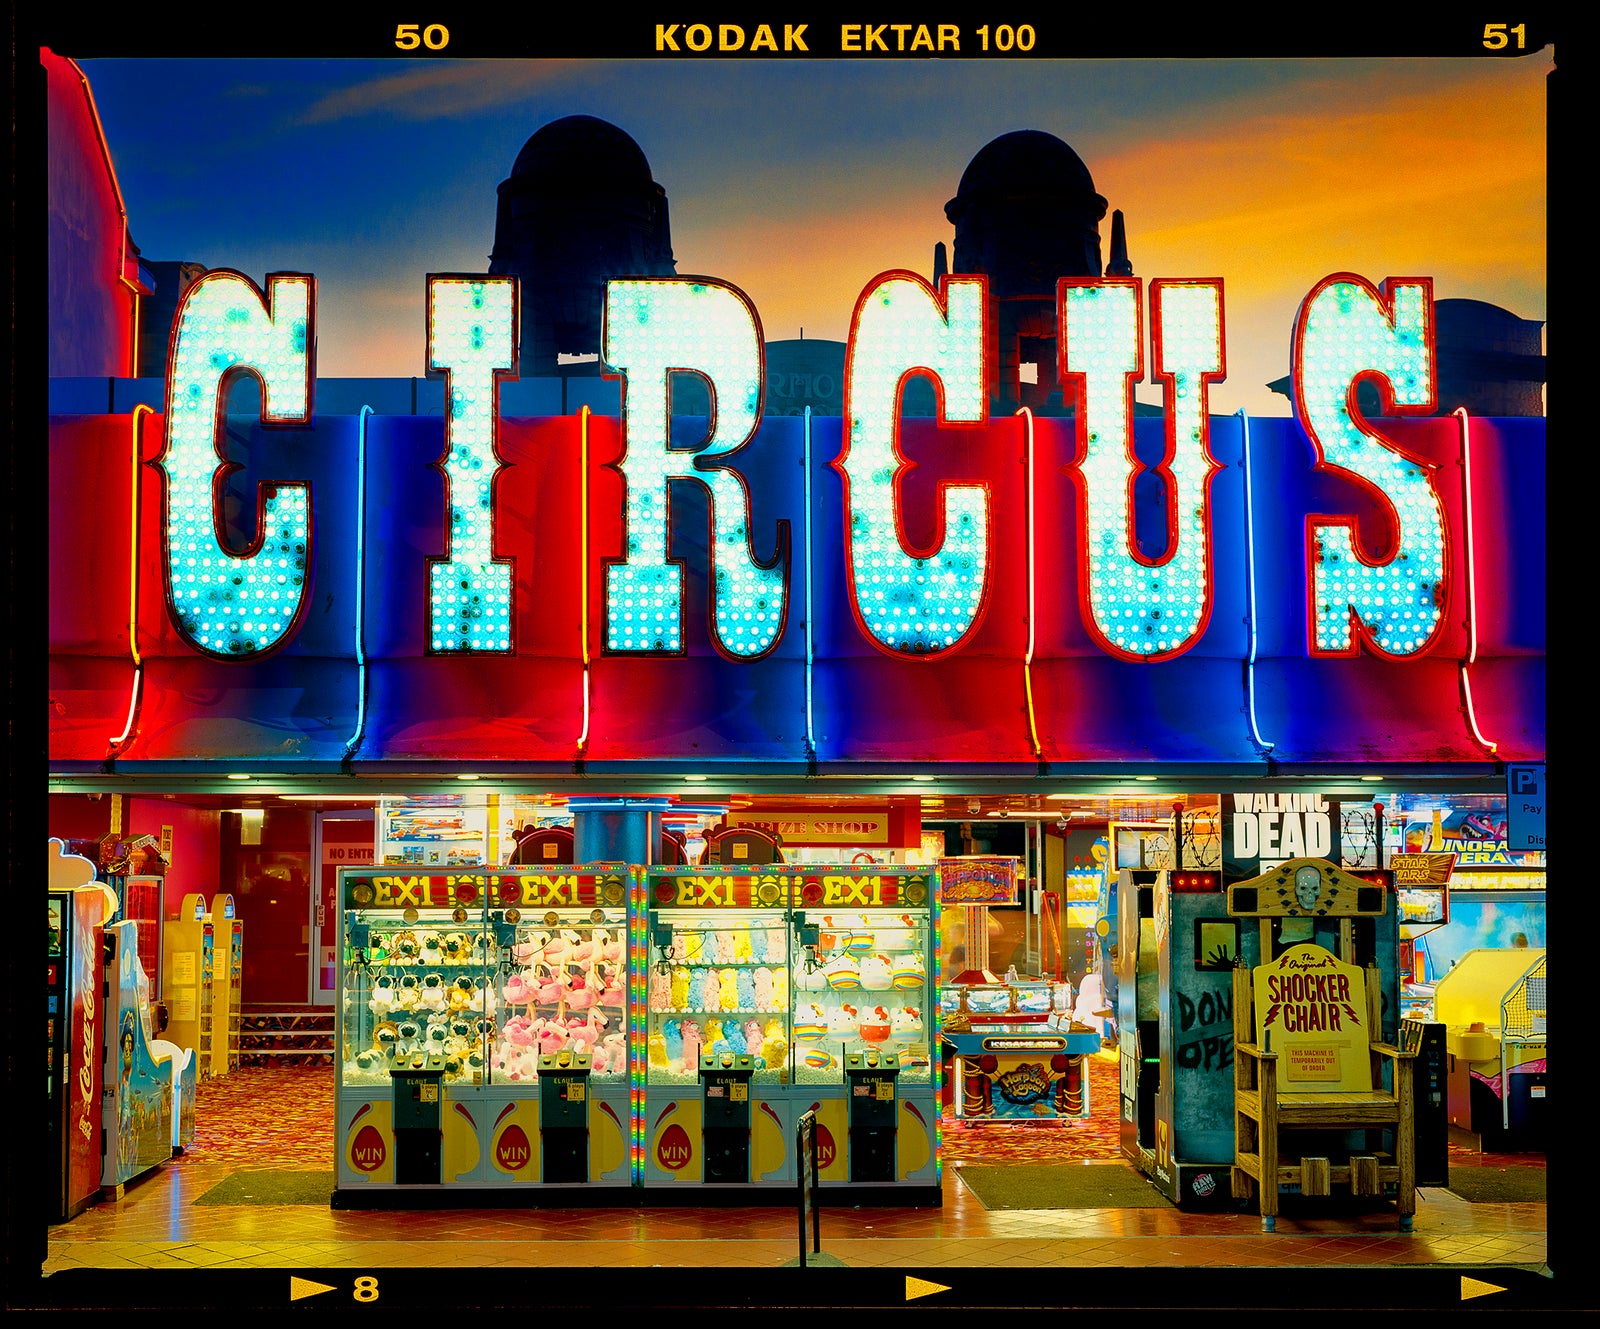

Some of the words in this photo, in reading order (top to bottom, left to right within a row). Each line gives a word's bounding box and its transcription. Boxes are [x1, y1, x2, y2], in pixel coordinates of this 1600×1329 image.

[394, 23, 450, 50] 50
[655, 23, 810, 52] KODAK
[841, 24, 961, 51] EKTAR
[975, 24, 1036, 52] 100
[1482, 23, 1526, 50] 51
[145, 267, 1453, 662] CIRCUS
[1523, 804, 1543, 814] Pay
[737, 821, 806, 834] PRIZE
[813, 821, 879, 834] SHOP
[1233, 812, 1331, 858] DEAD
[1428, 836, 1509, 852] DINOSA
[1528, 835, 1546, 844] Dis
[329, 848, 345, 859] NO
[348, 848, 374, 859] ENTR
[1460, 852, 1508, 864] ERA
[1391, 858, 1429, 869] STAR
[373, 876, 435, 906] EX1
[520, 876, 582, 906] EX1
[676, 876, 737, 906] EX1
[823, 876, 883, 906] EX1
[1288, 958, 1327, 972] Original
[1301, 953, 1315, 961] The
[1267, 973, 1352, 1004] SHOCKER
[1175, 987, 1233, 1032] DON
[1283, 1002, 1343, 1033] CHAIR
[1177, 1036, 1235, 1074] OPE
[1001, 1072, 1046, 1090] Harpoon
[1012, 1082, 1042, 1097] Lagoon
[355, 1147, 383, 1161] WIN
[500, 1146, 528, 1160] WIN
[660, 1146, 688, 1160] WIN
[817, 1145, 832, 1160] IN
[1192, 1173, 1214, 1191] RAW
[352, 1275, 380, 1303] 8
